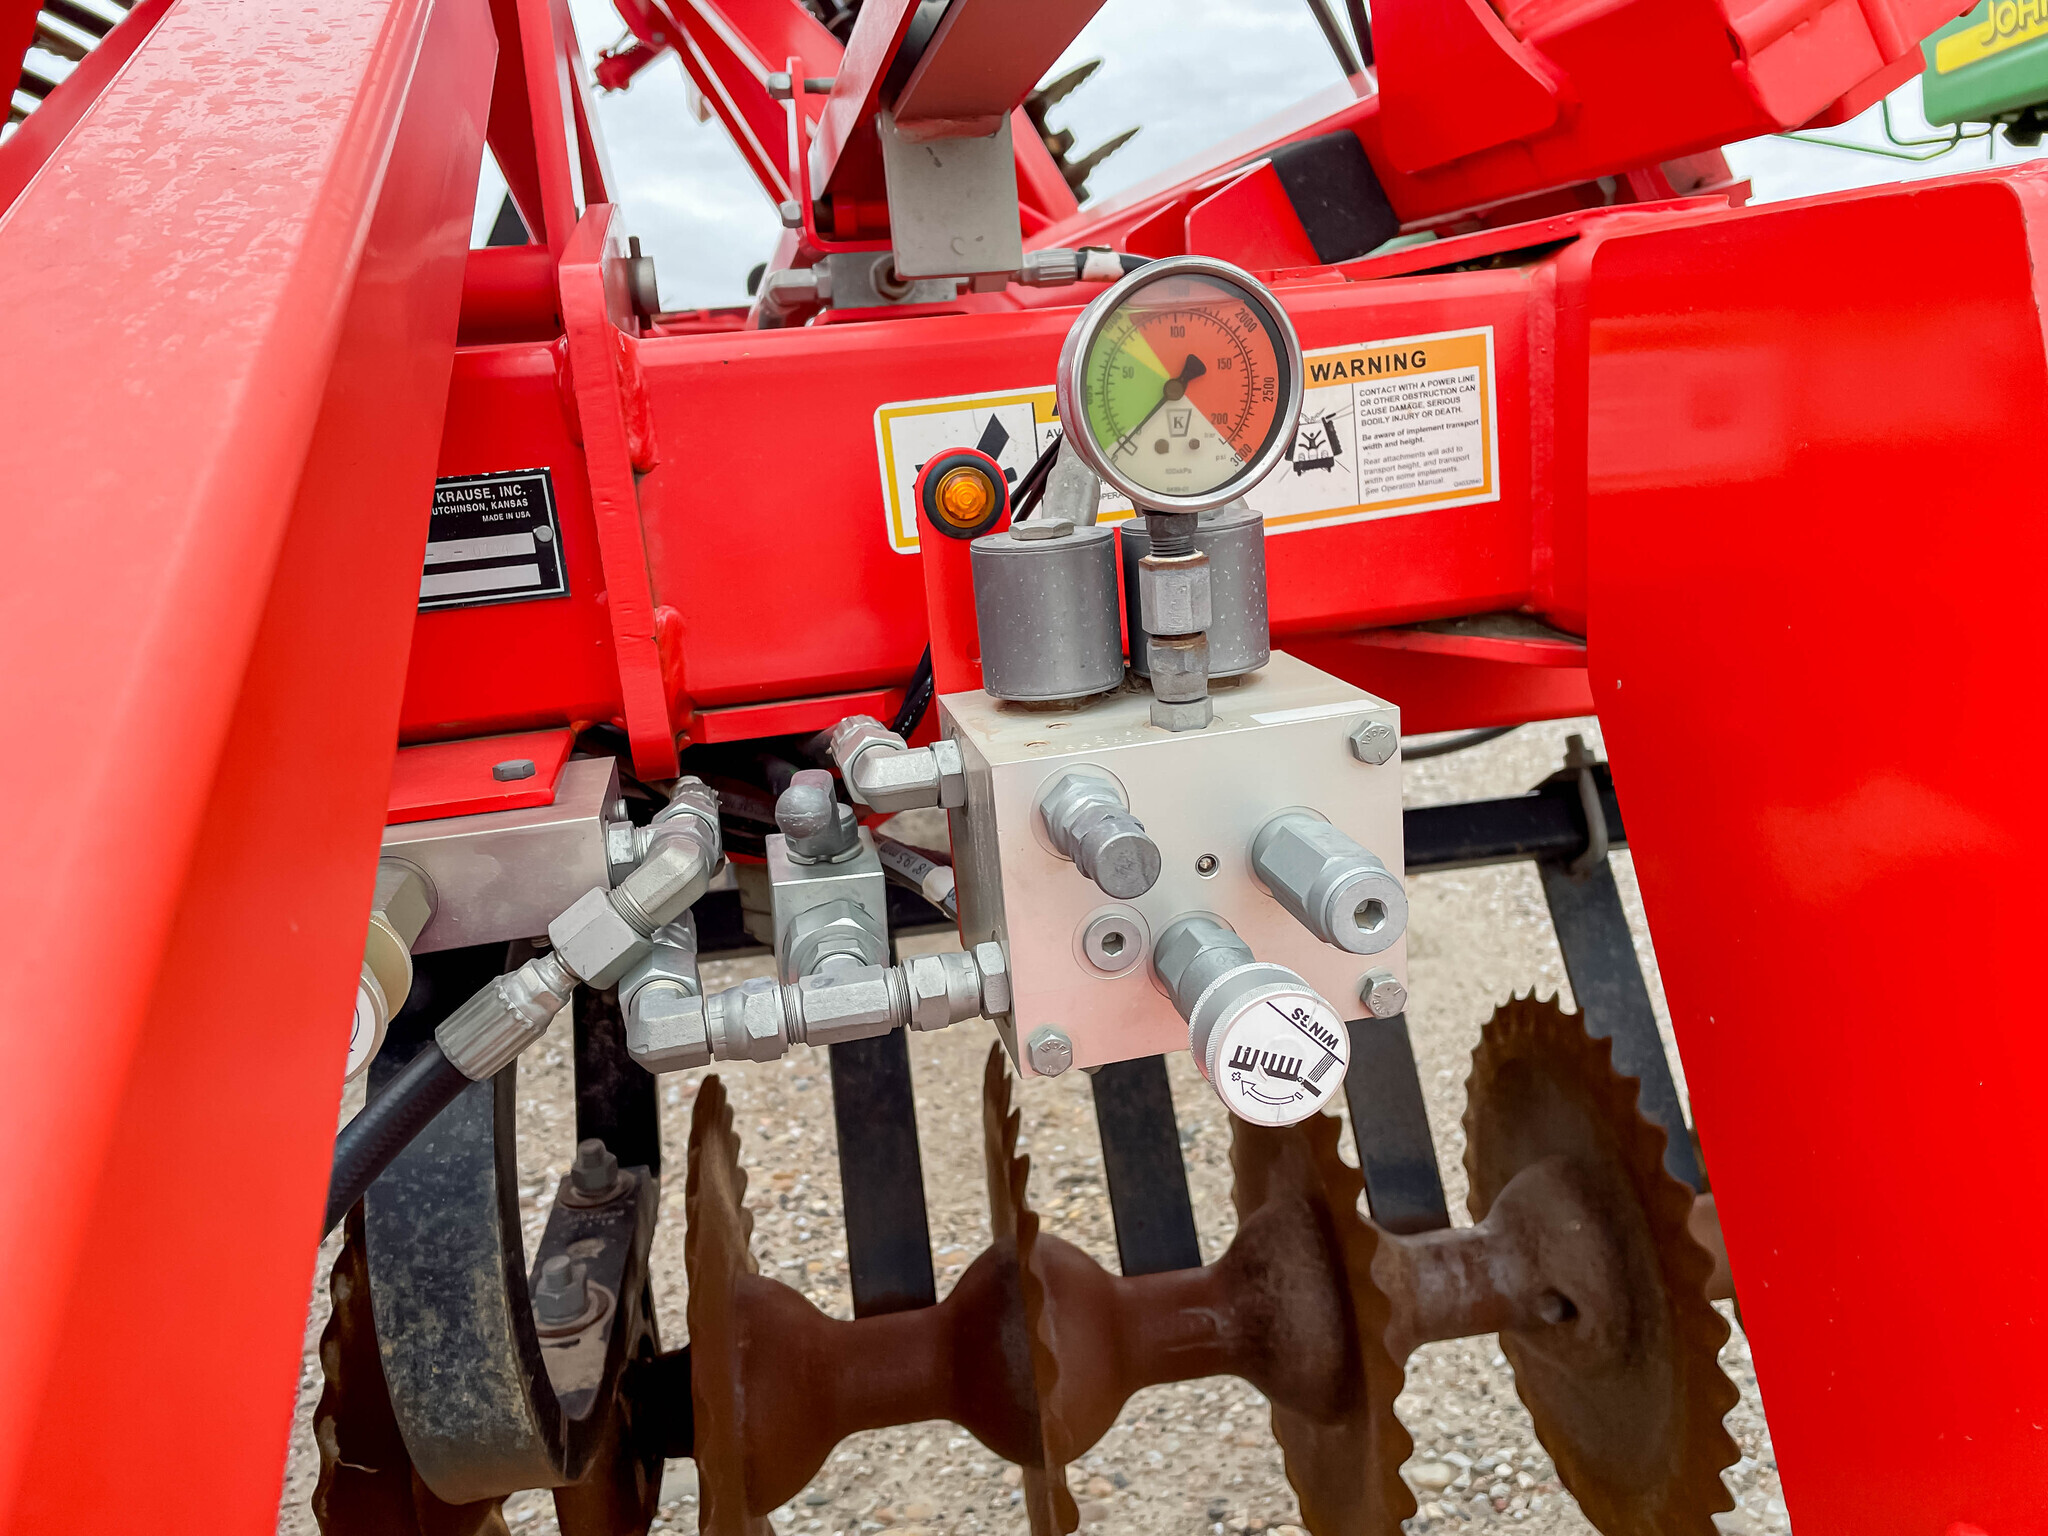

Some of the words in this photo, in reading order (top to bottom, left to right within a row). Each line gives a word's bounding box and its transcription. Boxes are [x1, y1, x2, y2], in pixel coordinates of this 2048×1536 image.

[1235, 308, 1258, 333] 2000
[1170, 325, 1185, 338] 100
[1122, 366, 1134, 379] 50
[1217, 358, 1232, 370] 150
[1310, 350, 1427, 382] WARNING
[1263, 376, 1275, 402] 2500
[1359, 385, 1397, 397] CONTACT
[1398, 382, 1418, 392] WITH
[1420, 381, 1426, 389] A
[1427, 377, 1456, 388] POWER
[1458, 374, 1475, 383] LINE
[1360, 399, 1371, 407] OR
[1373, 395, 1400, 405] OTHER
[1402, 388, 1457, 401] OBSTRUCTION
[1459, 384, 1476, 393] CAN
[1361, 406, 1387, 417] CAUSE
[1427, 396, 1461, 407] SERIOUS
[1173, 416, 1185, 429] K
[1211, 413, 1228, 425] 200
[1361, 416, 1390, 427] BODILY
[1392, 411, 1420, 422] INJURY
[1421, 410, 1433, 418] OR
[1434, 406, 1462, 416] DEATH.
[1374, 431, 1395, 440] aware
[1397, 428, 1405, 436] of
[1406, 424, 1444, 435] implement
[1445, 418, 1479, 429] transport
[1363, 442, 1382, 451] width
[1384, 440, 1398, 448] and
[1399, 436, 1425, 446] height.
[1230, 443, 1253, 467] 3000
[1363, 458, 1380, 466] Rear
[1382, 451, 1425, 463] attachments
[1427, 448, 1439, 456] will
[1441, 446, 1454, 454] add
[1364, 465, 1396, 475] transport
[1423, 458, 1437, 466] and
[1438, 454, 1470, 464] transport
[1365, 476, 1383, 485] width
[1396, 472, 1415, 480] some
[1381, 481, 1416, 492] Operation
[436, 488, 496, 503] KRAUSE,
[499, 484, 527, 498] INC.
[431, 502, 489, 516] UTCHINSON,
[490, 498, 529, 510] KANSAS
[482, 513, 504, 522] MADE
[505, 512, 514, 520] IN
[515, 510, 531, 519] USA
